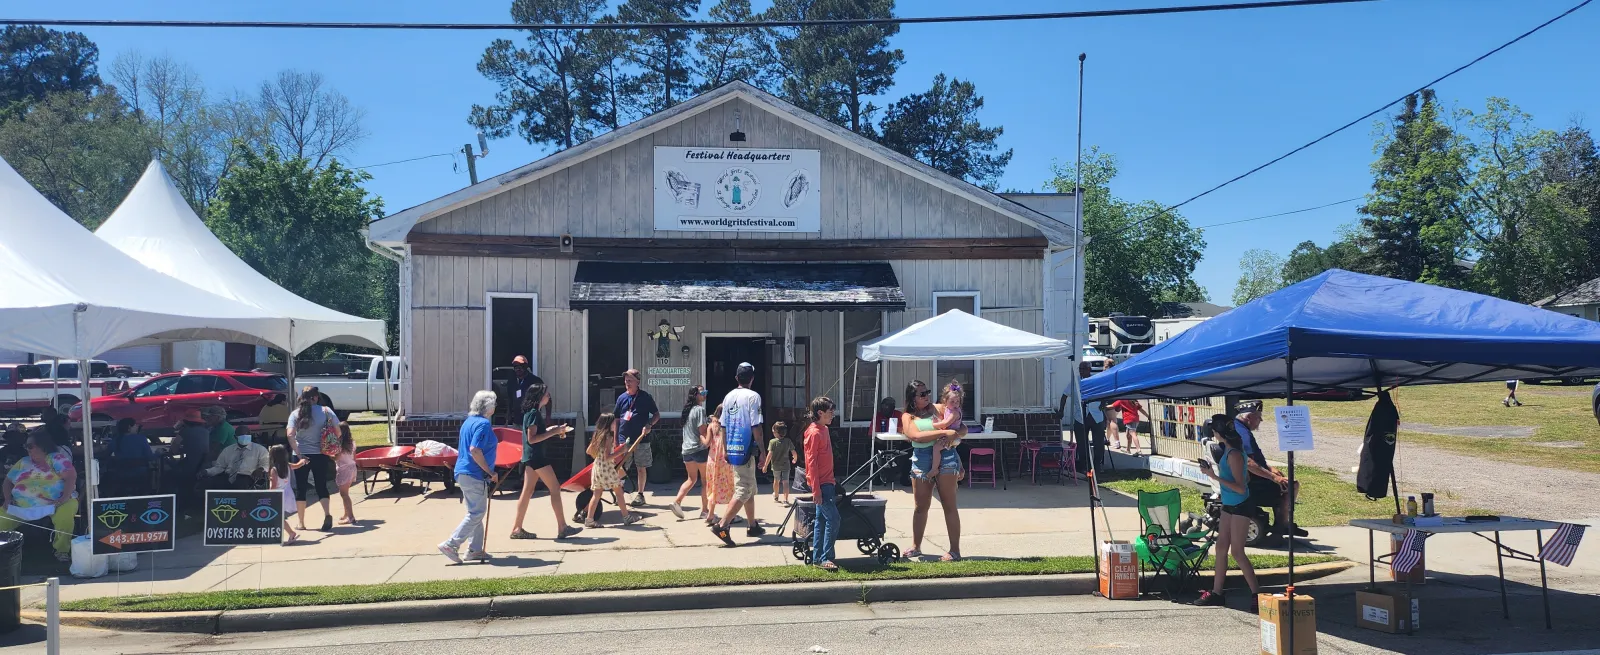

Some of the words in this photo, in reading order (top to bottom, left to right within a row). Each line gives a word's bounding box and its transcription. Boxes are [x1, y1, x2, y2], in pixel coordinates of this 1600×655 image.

[685, 150, 725, 160] Festival
[726, 151, 791, 163] Headquarters
[680, 218, 796, 228] www.worldgritsfestival.com
[100, 502, 126, 511] TASTE
[147, 500, 162, 508] SEE
[214, 497, 237, 505] TASTE
[256, 498, 272, 506] SEE
[109, 531, 168, 544] 843.471.9577
[207, 527, 245, 539] OYSTERS
[247, 527, 254, 539] &
[256, 527, 281, 539] FRIES
[1114, 565, 1136, 573] CLEAR
[1281, 609, 1315, 617] HRVEST
